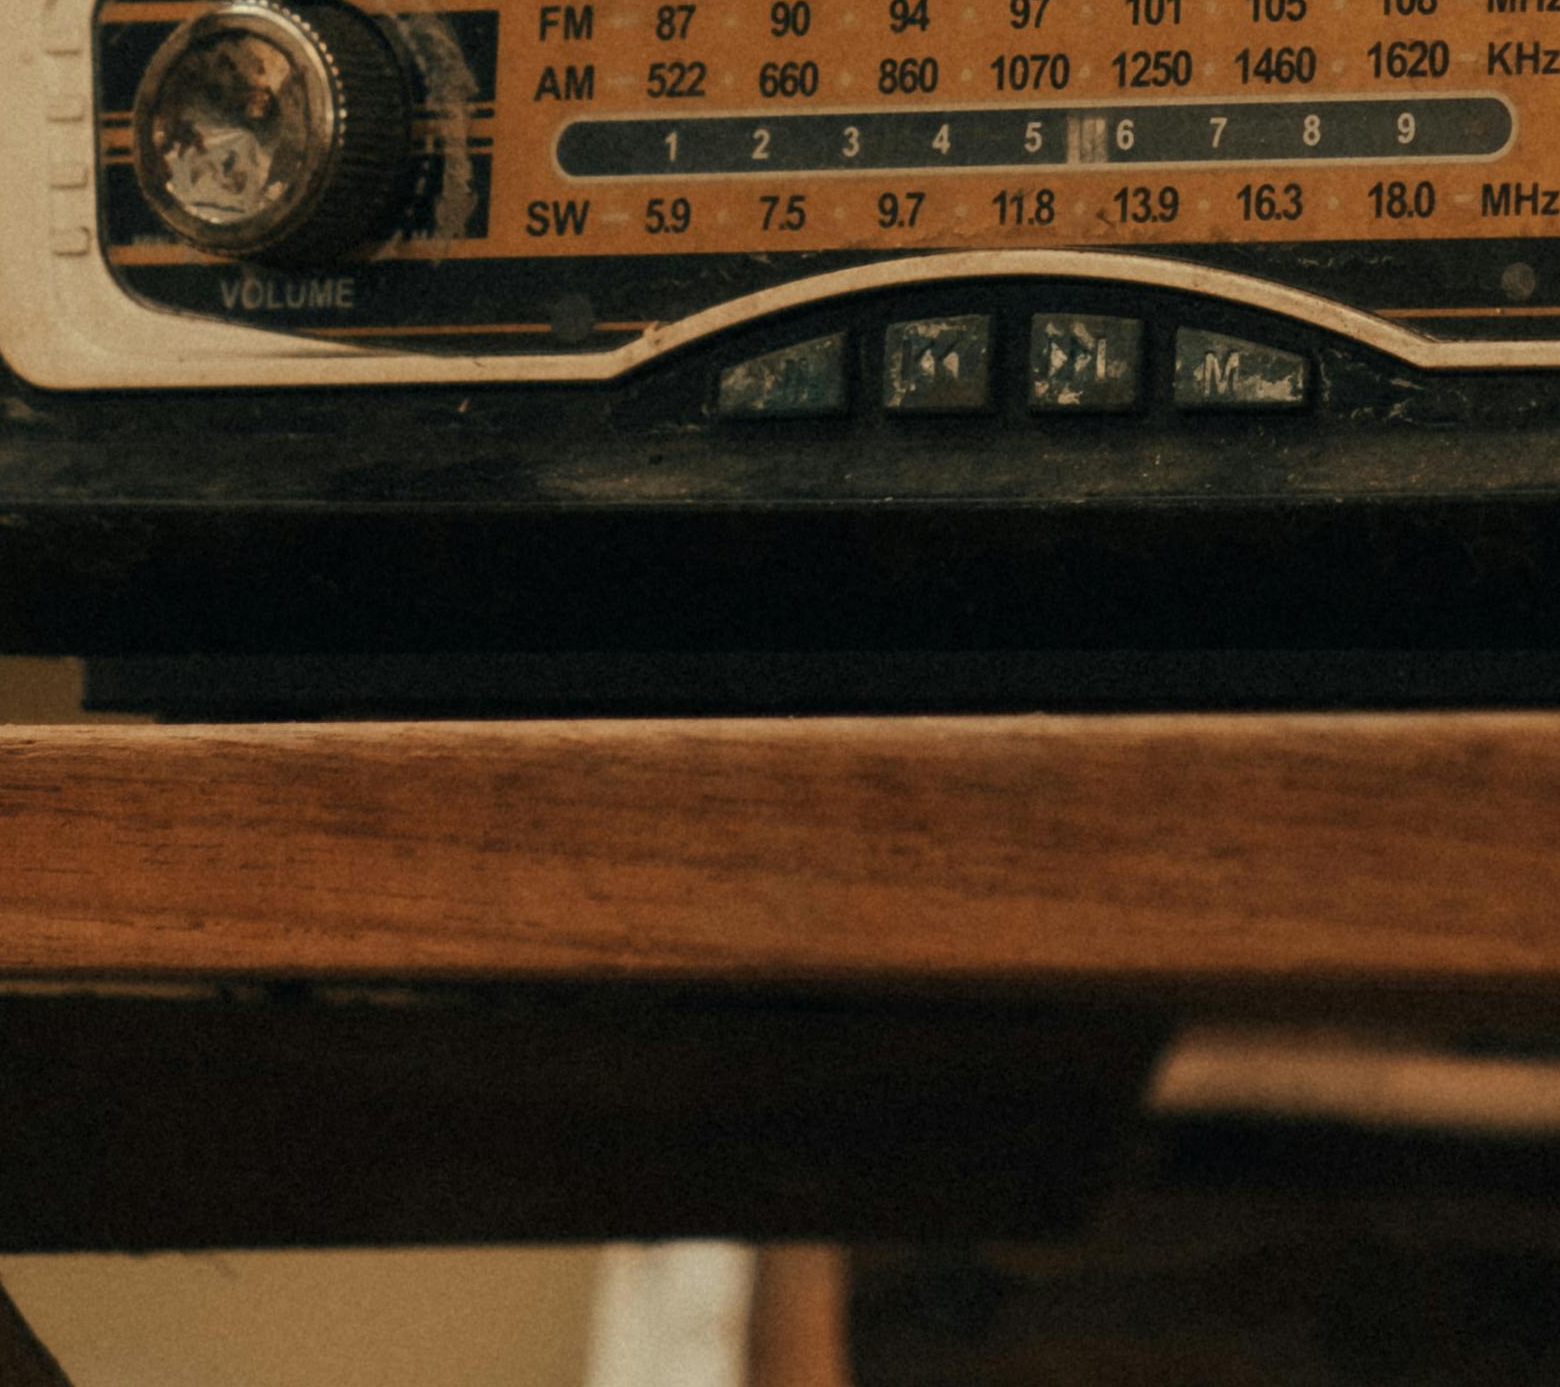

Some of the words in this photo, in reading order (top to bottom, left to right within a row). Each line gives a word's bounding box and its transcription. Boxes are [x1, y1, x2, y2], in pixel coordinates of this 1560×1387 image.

[539, 4, 594, 40] FM
[655, 4, 696, 41] 87
[771, 0, 811, 38] 90
[534, 65, 595, 101] AM
[647, 60, 707, 99] 522
[758, 60, 819, 98] 660
[878, 57, 939, 95] 860
[991, 53, 1071, 91] 1070
[1112, 50, 1192, 88] 1250
[1236, 47, 1317, 84] 1460
[1368, 40, 1450, 79] 1620
[1487, 41, 1560, 76] KHz
[665, 132, 678, 161] 1
[752, 128, 770, 160] 2
[843, 126, 860, 158] 3
[932, 124, 950, 154] 4
[1025, 121, 1043, 153] 5
[1116, 119, 1134, 150] 6
[1210, 117, 1228, 148] 7
[1303, 114, 1321, 146] 8
[1397, 112, 1416, 144] 9
[526, 200, 590, 237] SW
[645, 197, 691, 235] 5.9
[760, 194, 806, 231] 7.5
[878, 191, 926, 229] 9.7
[993, 188, 1055, 227] 11.8
[1114, 186, 1180, 223] 13.9
[1237, 183, 1303, 221] 16.3
[1369, 181, 1436, 219] 18.0
[1481, 182, 1560, 217] MHz
[220, 277, 355, 311] VOLUME
